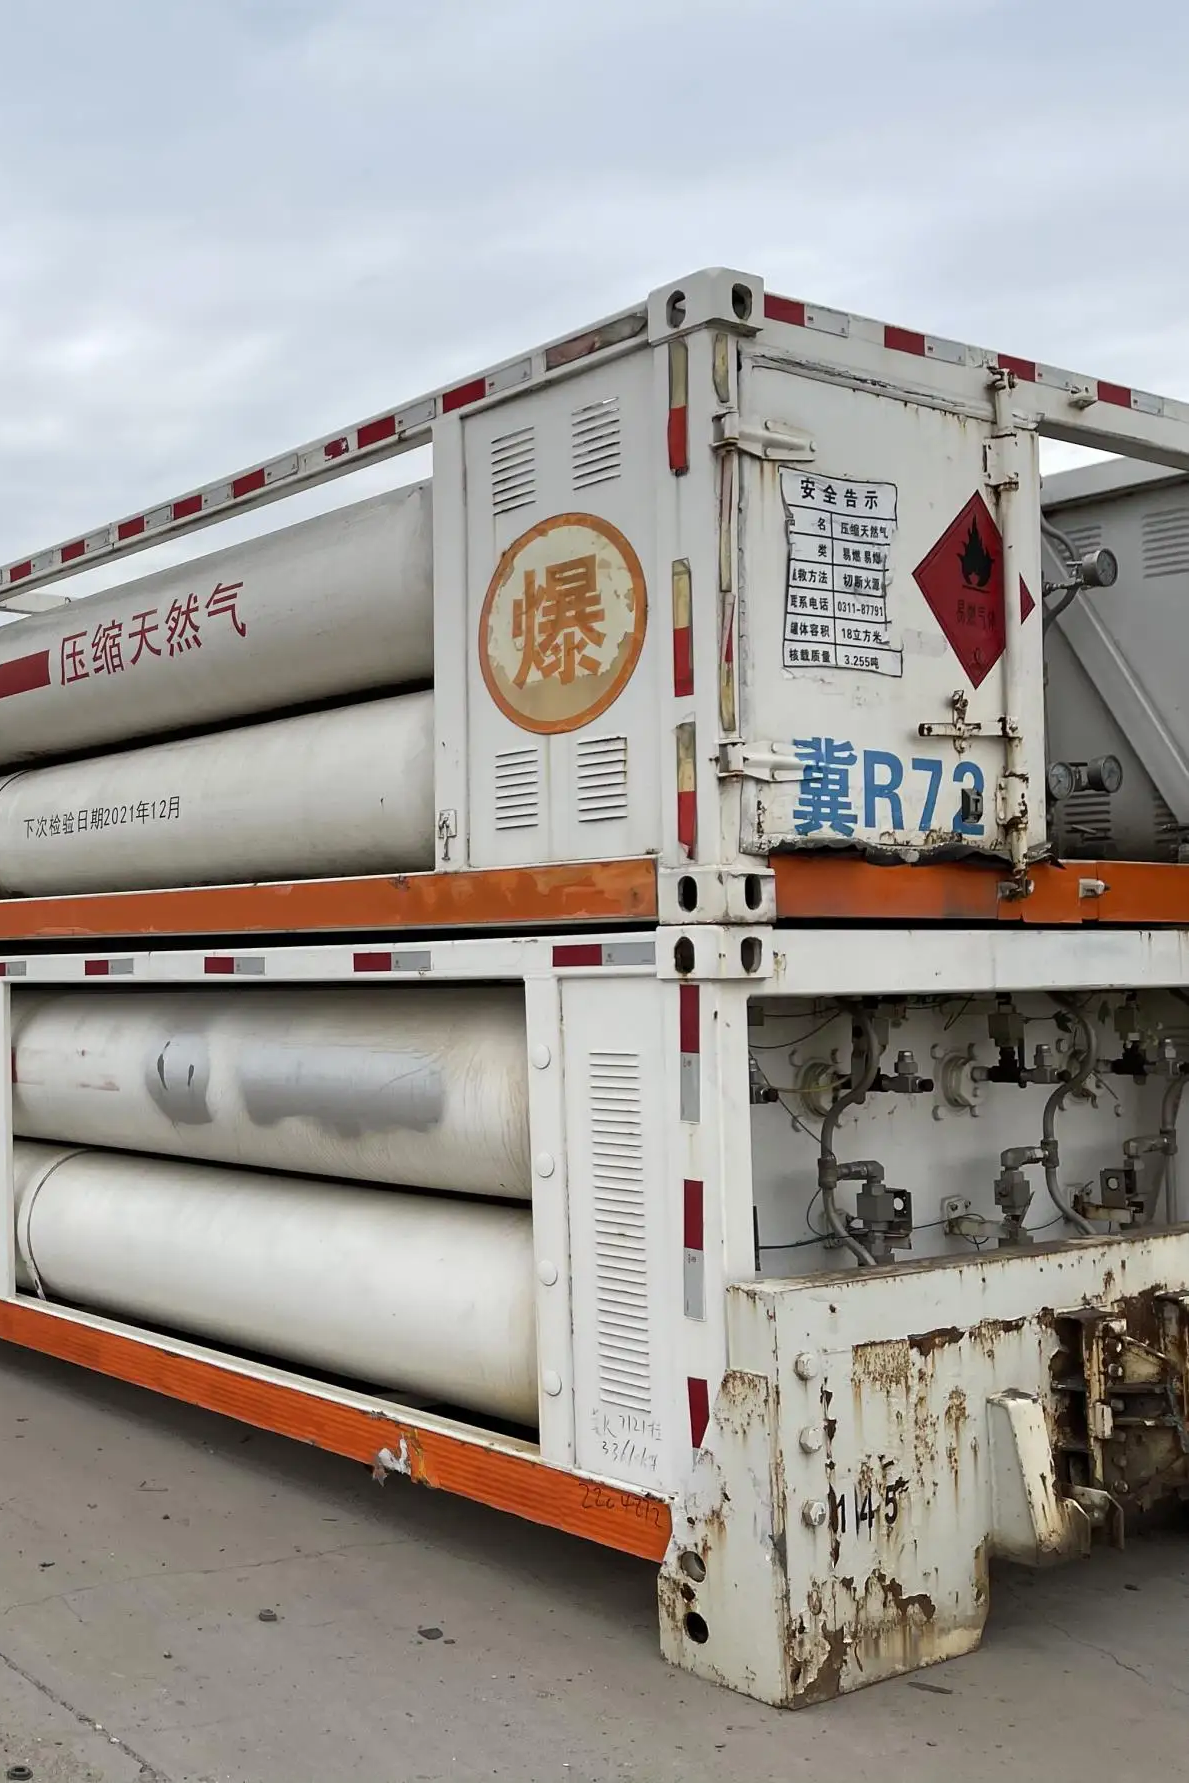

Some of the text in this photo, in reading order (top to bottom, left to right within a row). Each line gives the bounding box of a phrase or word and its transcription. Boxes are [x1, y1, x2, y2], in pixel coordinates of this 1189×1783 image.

[801, 478, 878, 509] 安全告示
[840, 522, 888, 539] 压缩天然气
[843, 573, 880, 591] 切断火源
[60, 581, 247, 686] 压缩天然气
[512, 553, 606, 690] 爆
[793, 737, 984, 837] 冀R72
[23, 796, 181, 839] 下次检验日期2021年12月
